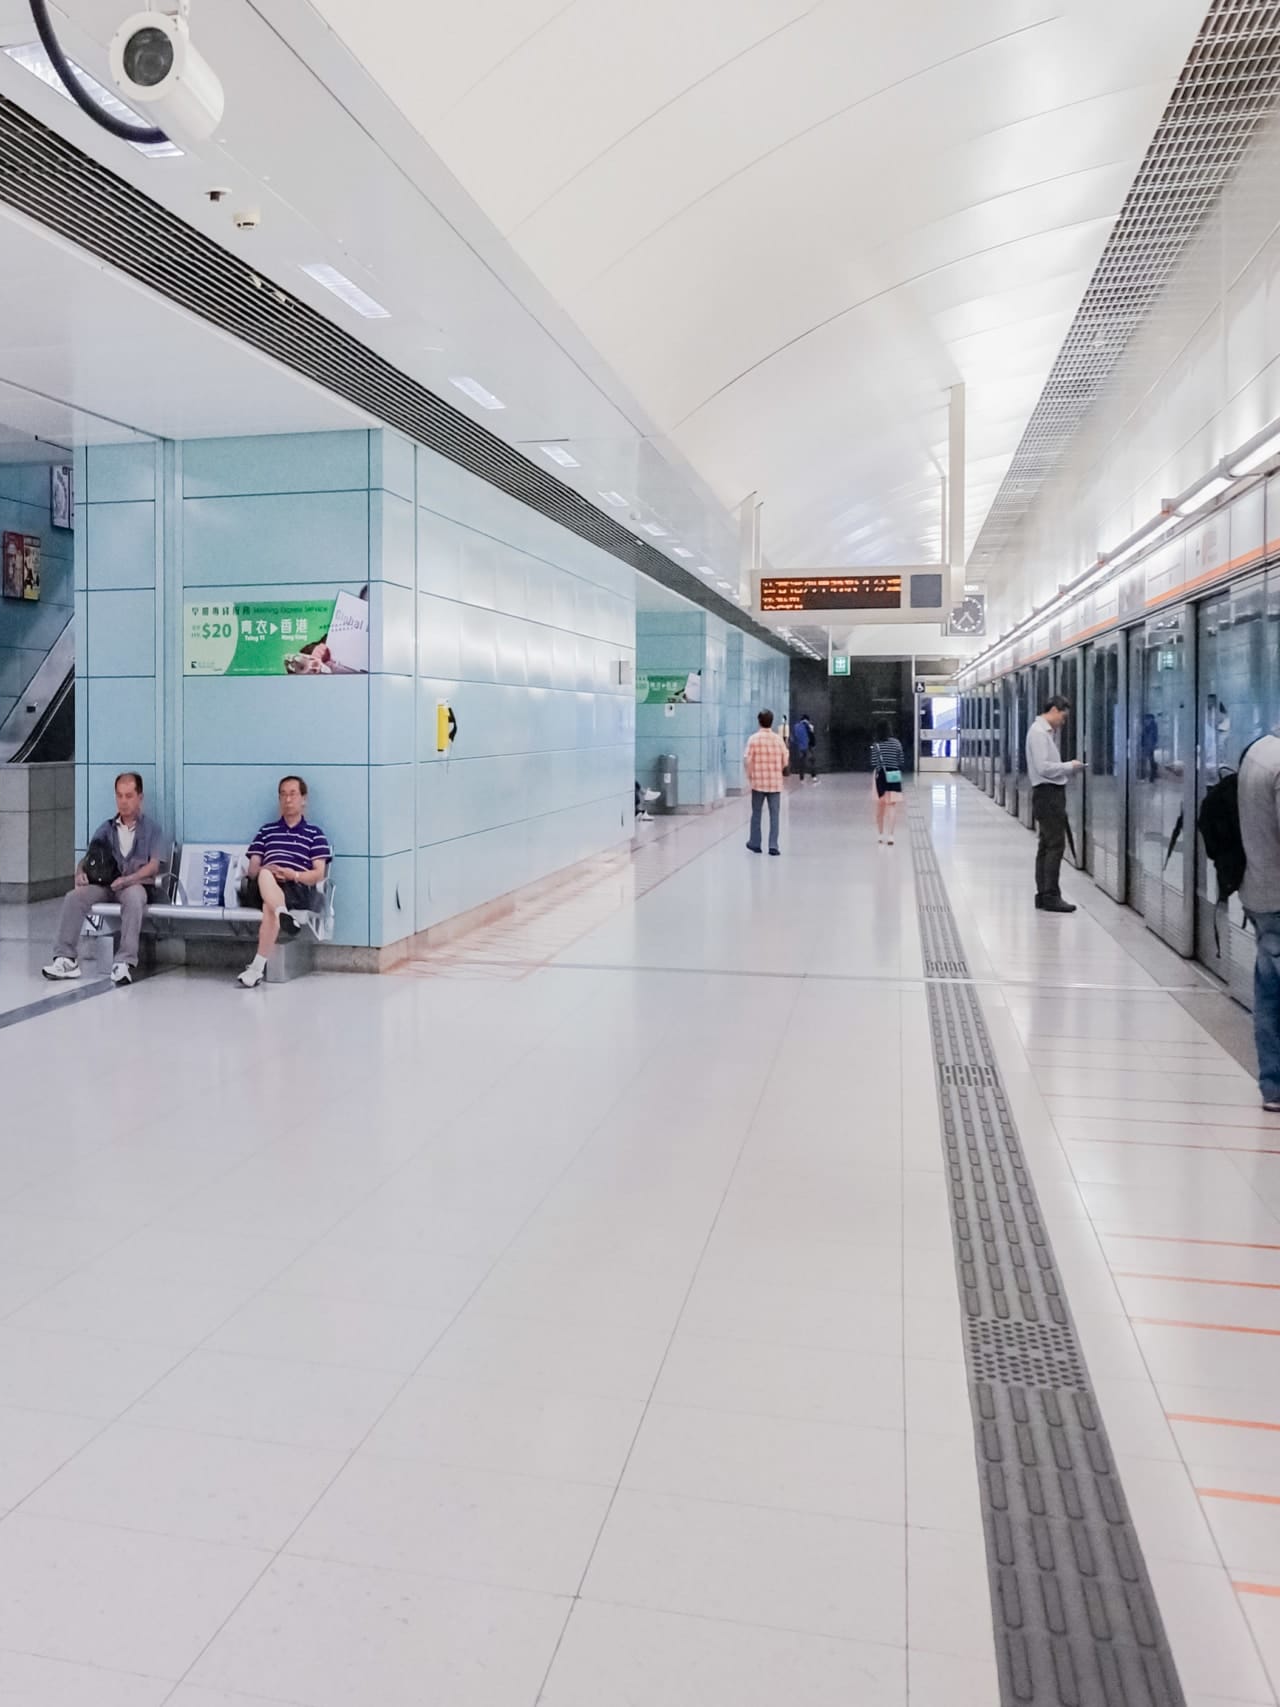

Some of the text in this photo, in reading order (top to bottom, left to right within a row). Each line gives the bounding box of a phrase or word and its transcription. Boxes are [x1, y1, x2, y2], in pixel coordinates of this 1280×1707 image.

[202, 622, 232, 640] $20
[240, 618, 308, 634] 青衣 香港
